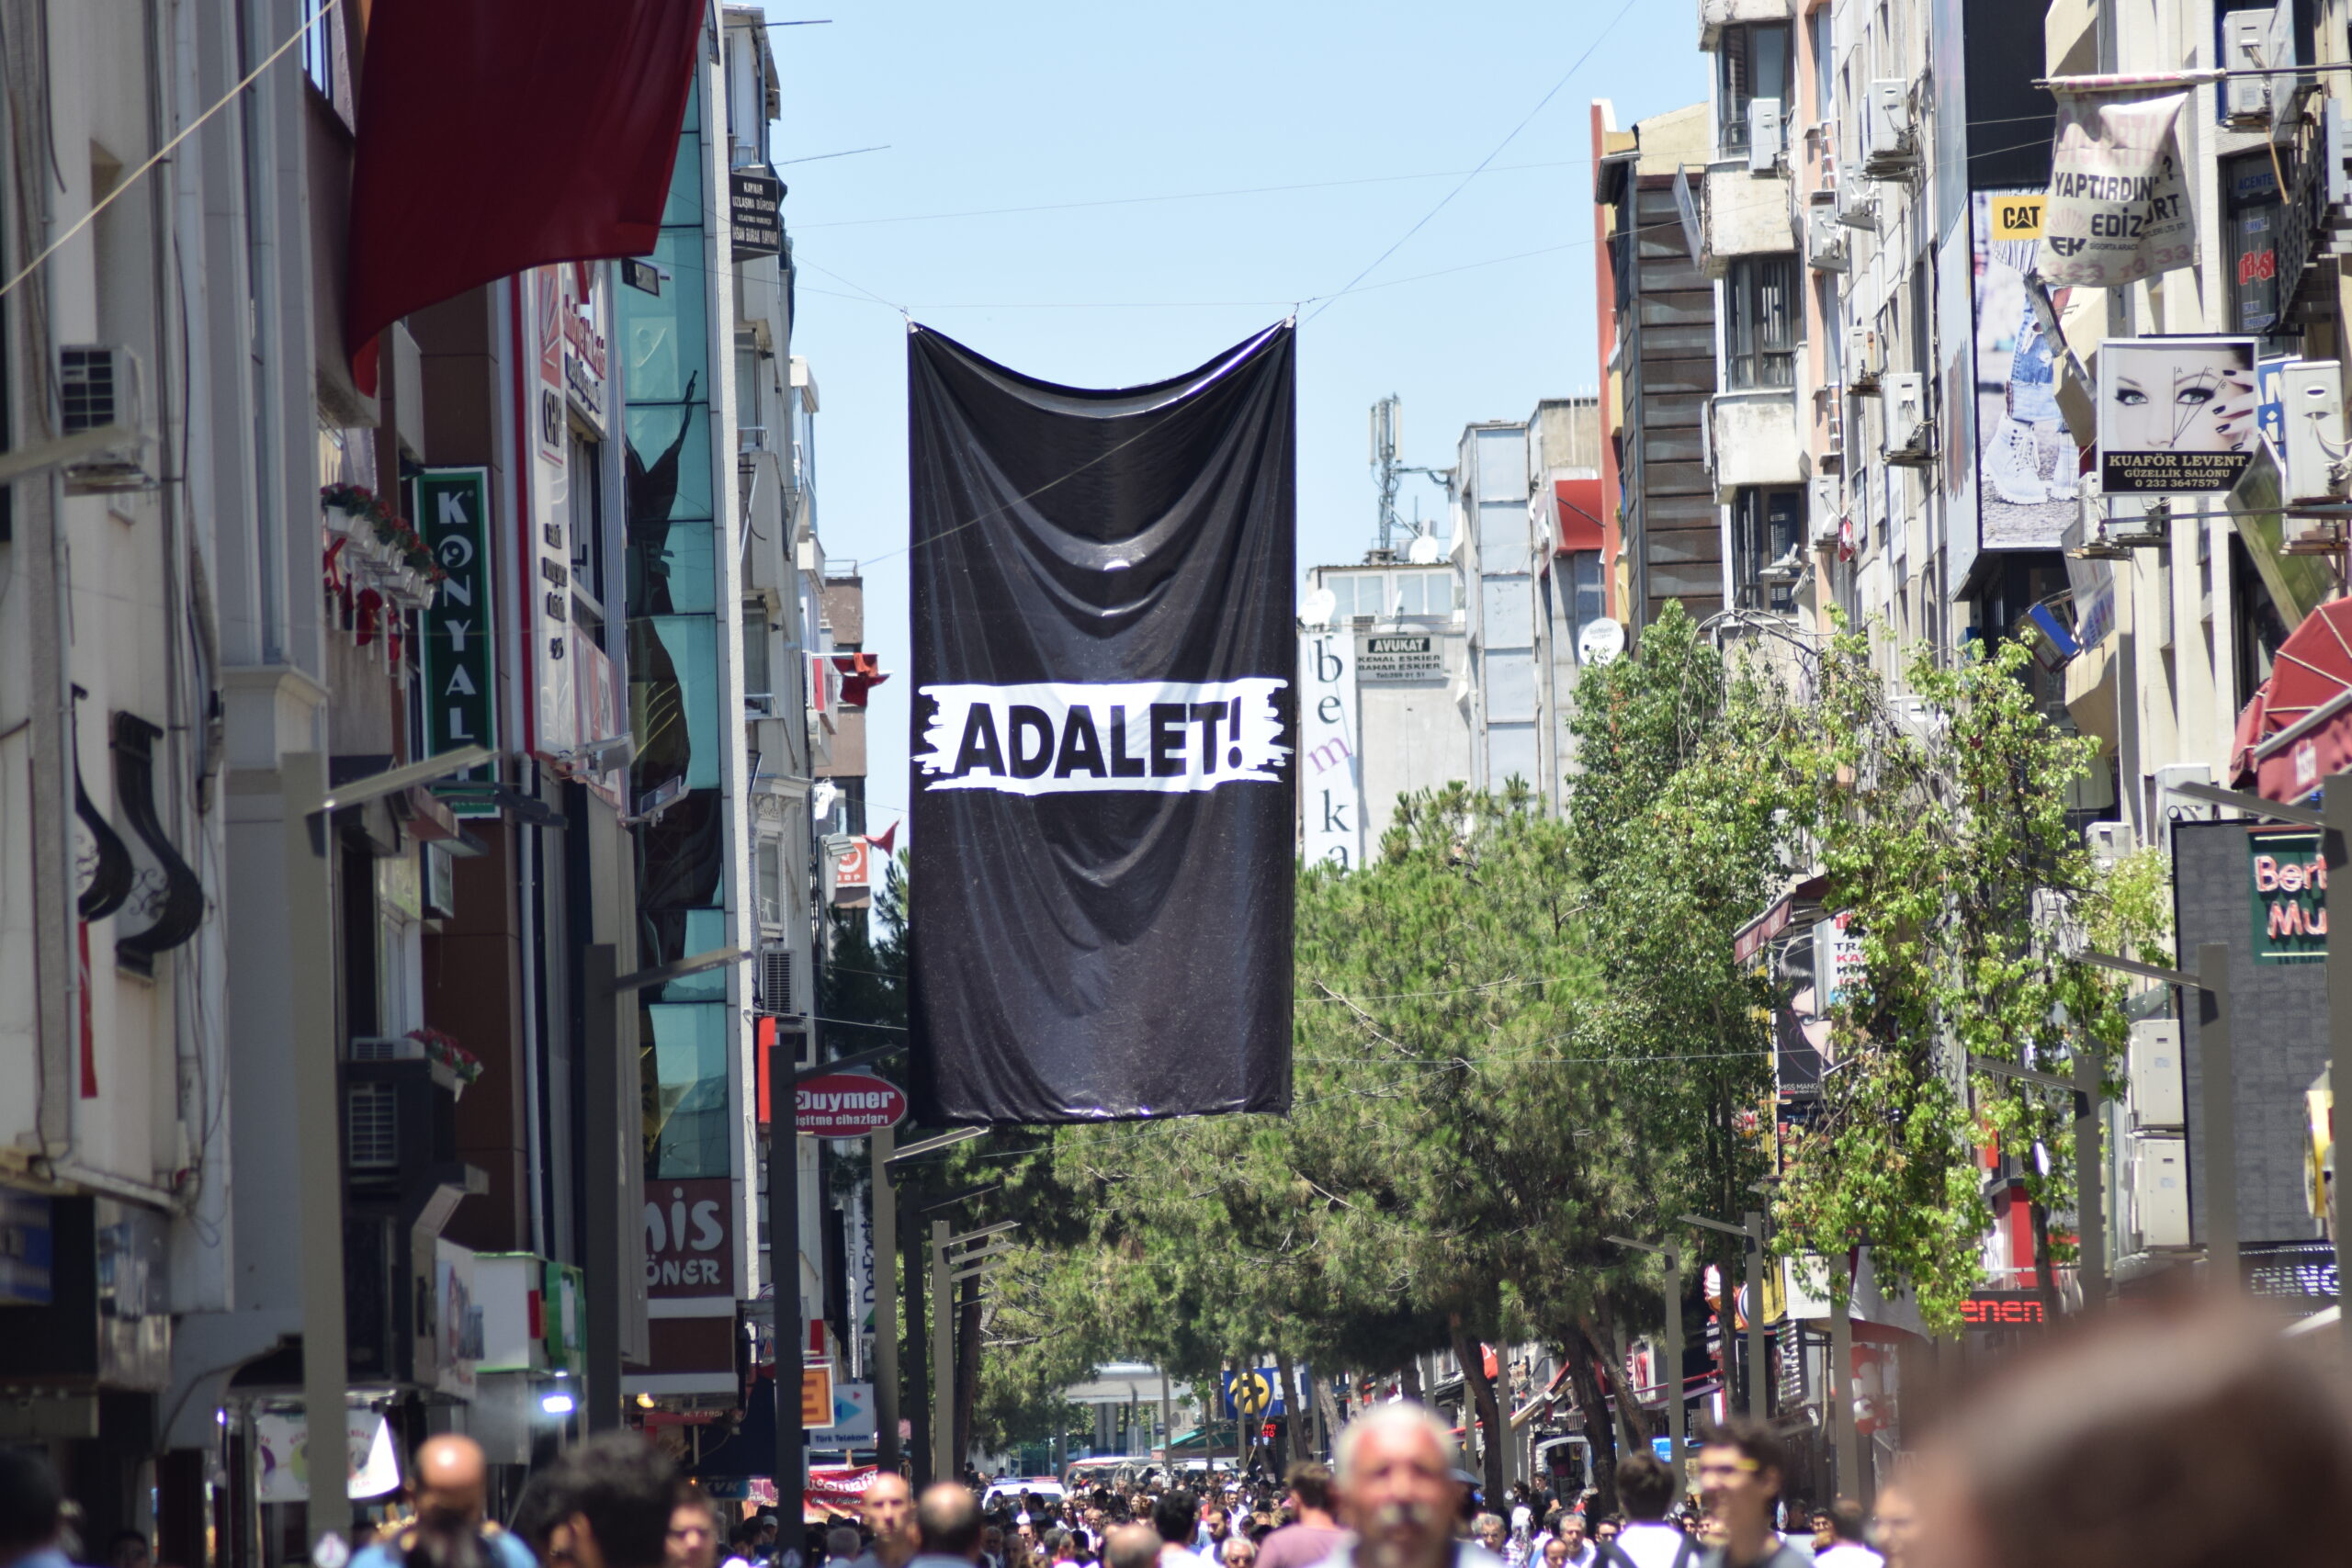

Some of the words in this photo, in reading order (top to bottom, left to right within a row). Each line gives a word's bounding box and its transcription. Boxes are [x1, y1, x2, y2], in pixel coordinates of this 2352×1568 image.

[2054, 171, 2159, 202] YAPTIRDIN
[2003, 207, 2041, 229] CAT
[2109, 453, 2177, 467] KUAFÖR
[2124, 468, 2181, 478] GÜZELLİK
[2184, 469, 2231, 478] SALONU
[2145, 479, 2167, 488] 232
[2171, 479, 2220, 488] 3647579
[1374, 638, 1425, 653] AVUKAT
[1357, 655, 1396, 663] KEMAL
[1358, 663, 1396, 671] BAHAR
[954, 695, 1243, 779] ADALET!
[1796, 1082, 1818, 1091] MANG
[835, 1113, 888, 1125] cihazları
[815, 1435, 832, 1443] Türk
[835, 1434, 869, 1442] Telekom
